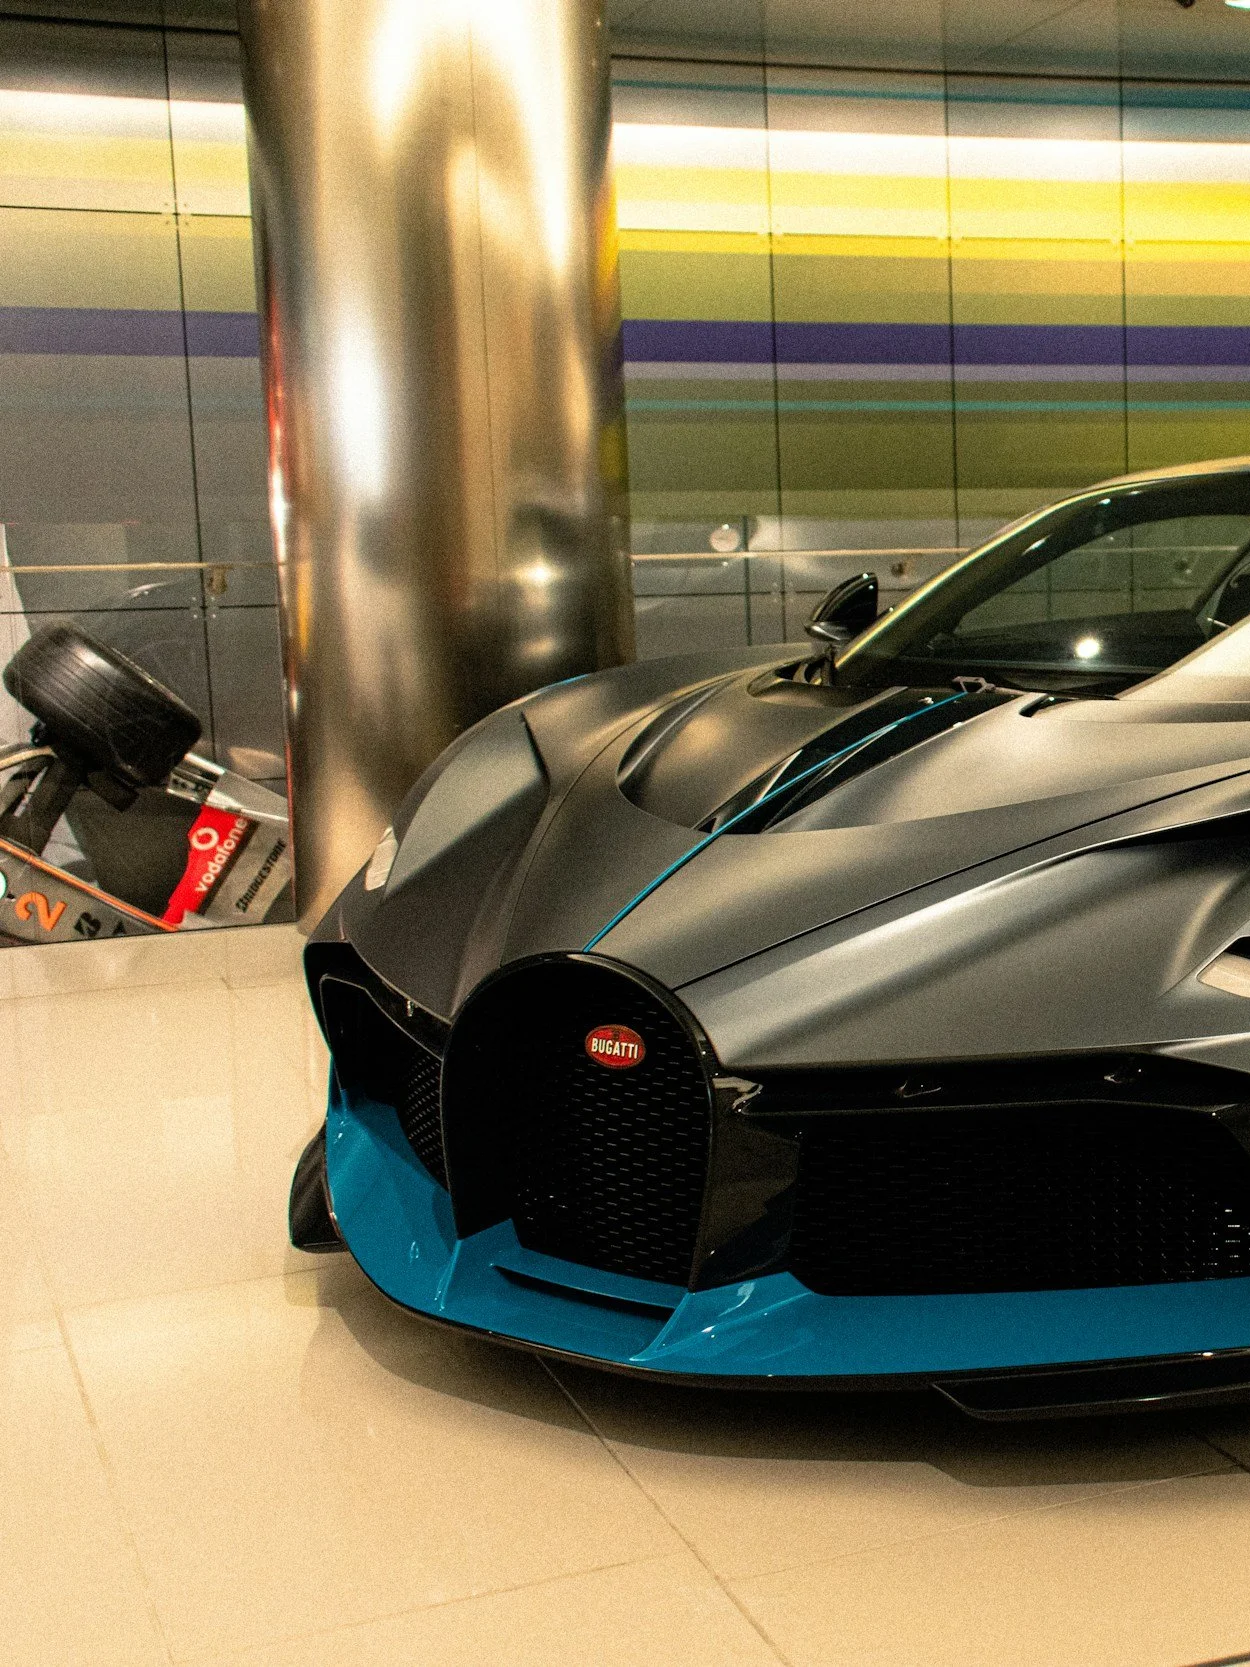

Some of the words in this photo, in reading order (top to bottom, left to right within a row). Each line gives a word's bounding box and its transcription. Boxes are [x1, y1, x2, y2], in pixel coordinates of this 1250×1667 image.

[194, 816, 248, 892] vodafone
[15, 891, 68, 932] 2
[591, 1037, 638, 1059] BUGATTI
